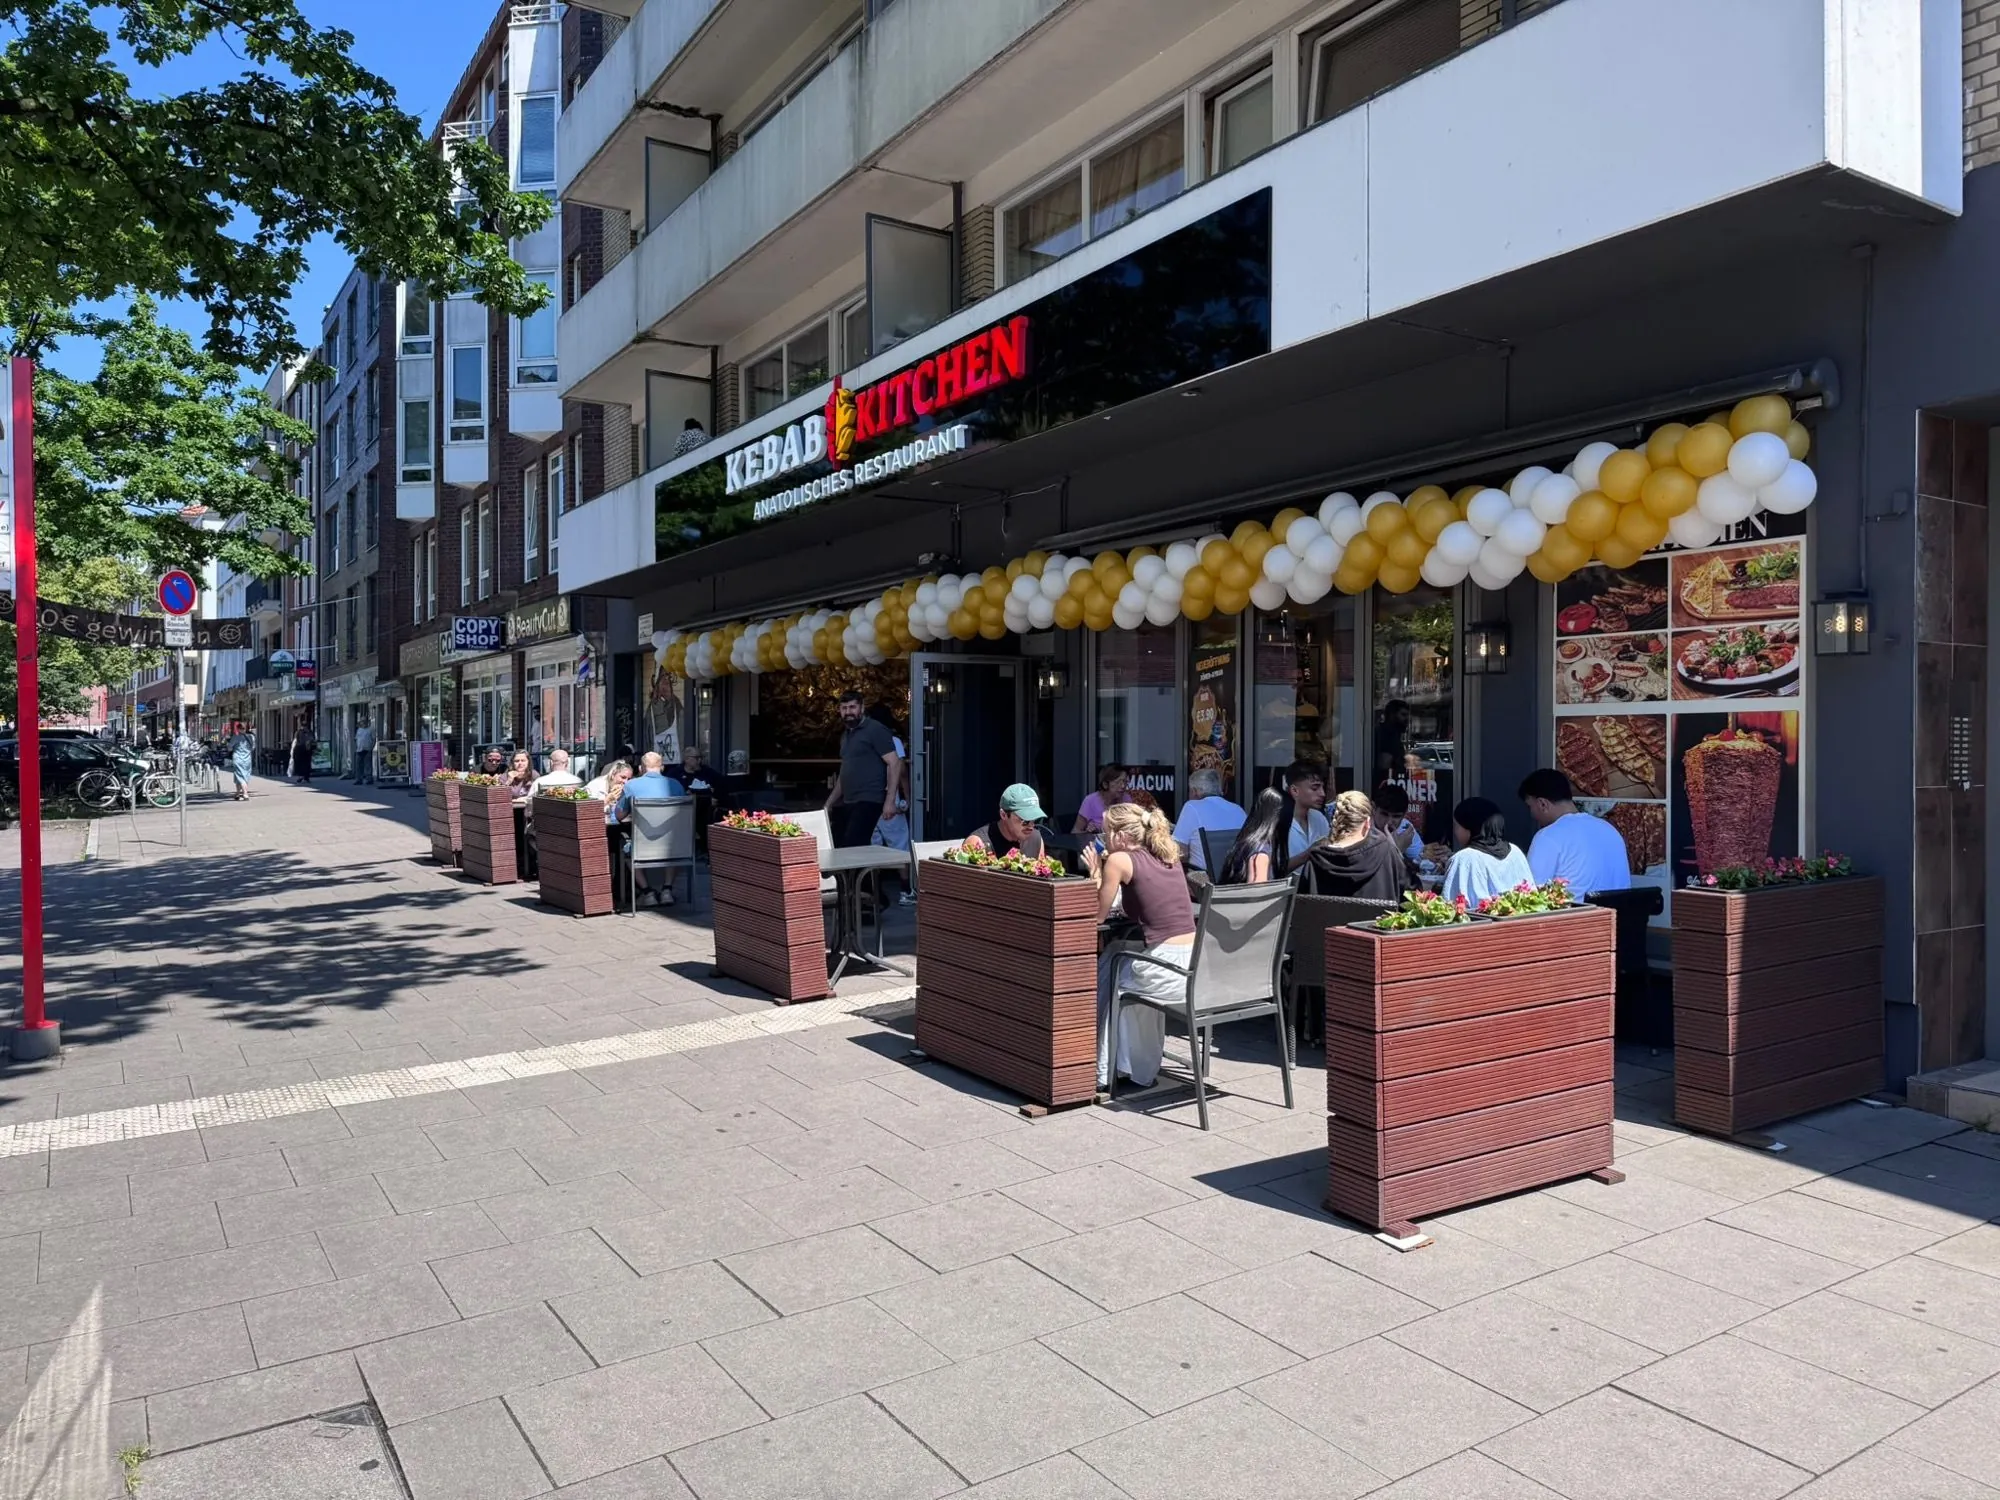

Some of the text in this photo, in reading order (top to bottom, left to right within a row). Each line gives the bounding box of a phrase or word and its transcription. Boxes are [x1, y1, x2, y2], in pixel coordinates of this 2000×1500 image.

[725, 315, 1030, 496] KEBAB KITCHEN
[753, 424, 970, 521] ANATOLISCHES RESTAURANT
[85, 620, 211, 644] gewinn
[455, 618, 499, 634] COPY
[515, 607, 557, 640] BeautyCut
[455, 634, 499, 646] SHOP
[1126, 774, 1175, 791] MACUN
